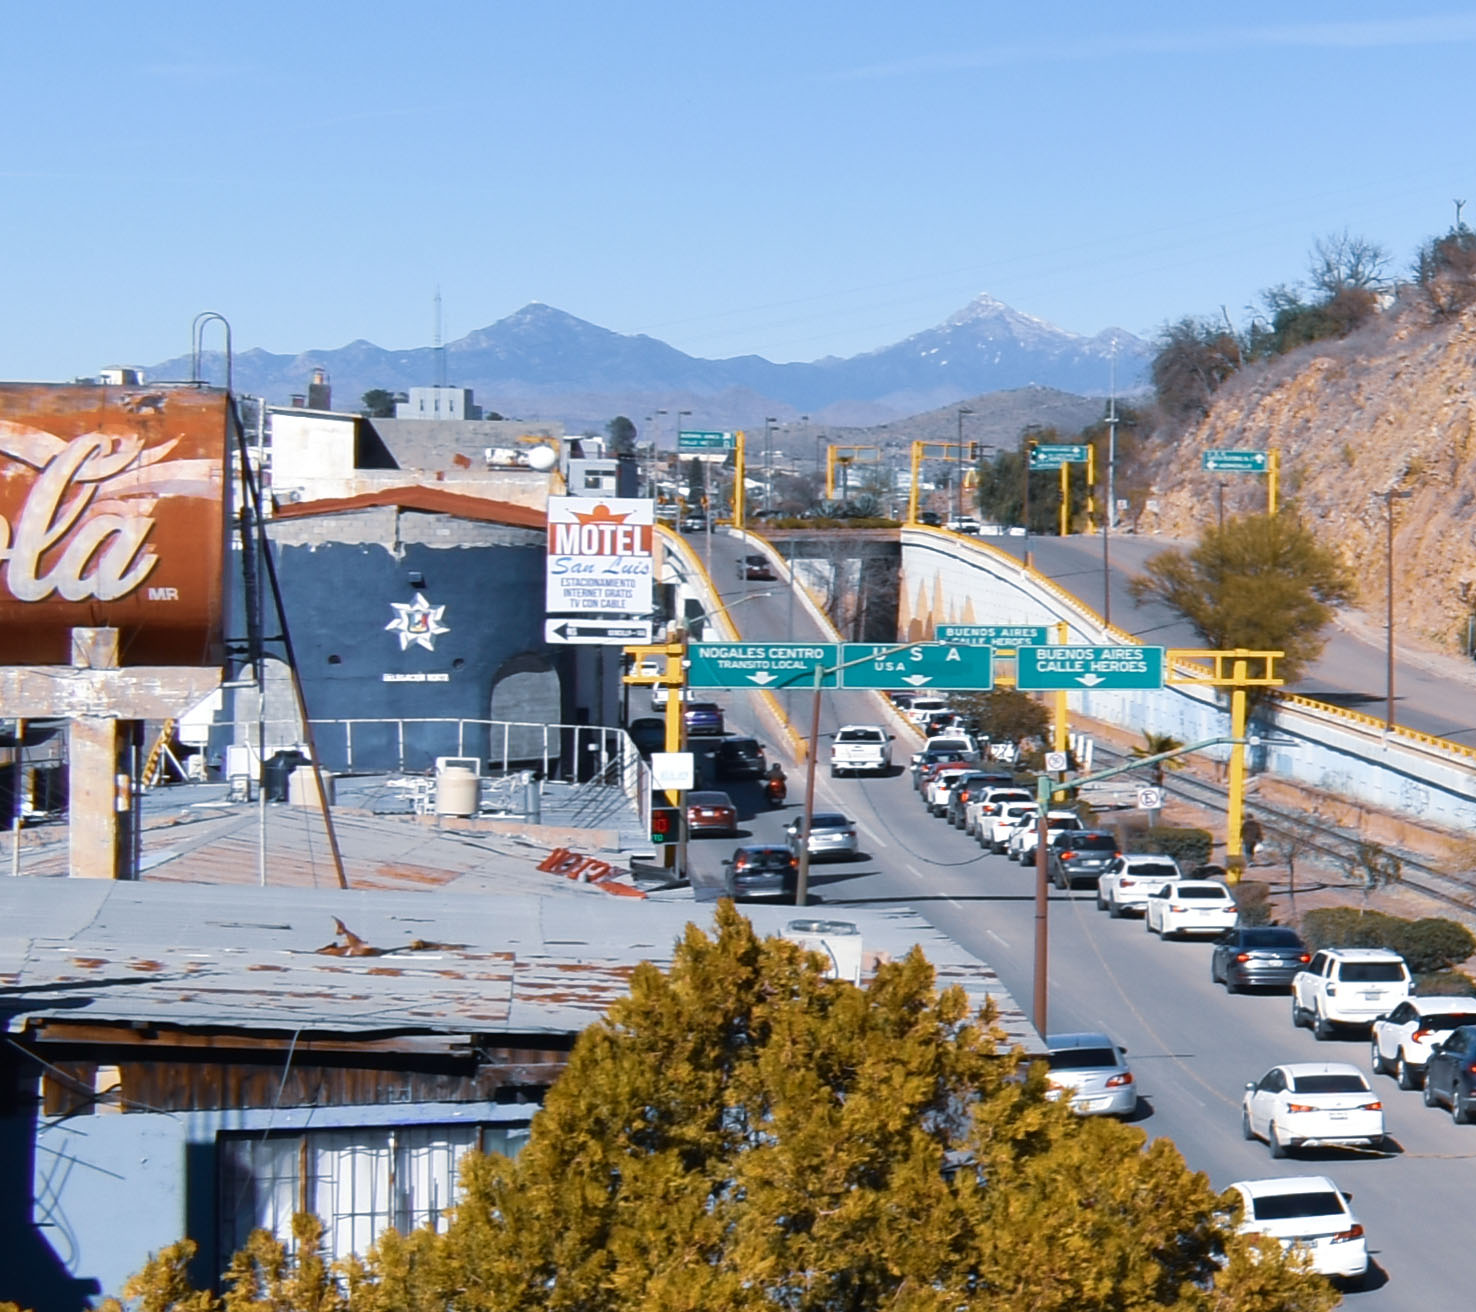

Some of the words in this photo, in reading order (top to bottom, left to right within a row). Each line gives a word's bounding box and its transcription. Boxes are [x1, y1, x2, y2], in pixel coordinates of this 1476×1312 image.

[555, 524, 650, 556] MOTEL
[551, 557, 595, 575] San
[602, 556, 649, 575] Luis
[561, 578, 636, 588] ESTACIONAMIENTO
[148, 588, 179, 601] MR
[563, 589, 601, 598] INTERNET
[605, 589, 633, 598] GRATIS
[570, 599, 580, 608] TV
[582, 599, 598, 608] CON
[600, 599, 626, 608] CABLE
[946, 628, 996, 637] BUENOS
[1001, 628, 1038, 637] AIRES
[699, 647, 765, 659] NOGALES
[768, 647, 824, 659] CENTRO
[909, 646, 924, 661] S
[945, 646, 961, 661] A
[1035, 648, 1094, 660] BUENOS
[1101, 649, 1144, 660] AIRES
[717, 660, 770, 669] TRANSITO
[771, 660, 808, 670] LOCAL
[874, 661, 906, 672] USA
[1036, 661, 1083, 673] CALLE
[1090, 661, 1148, 673] HEROES
